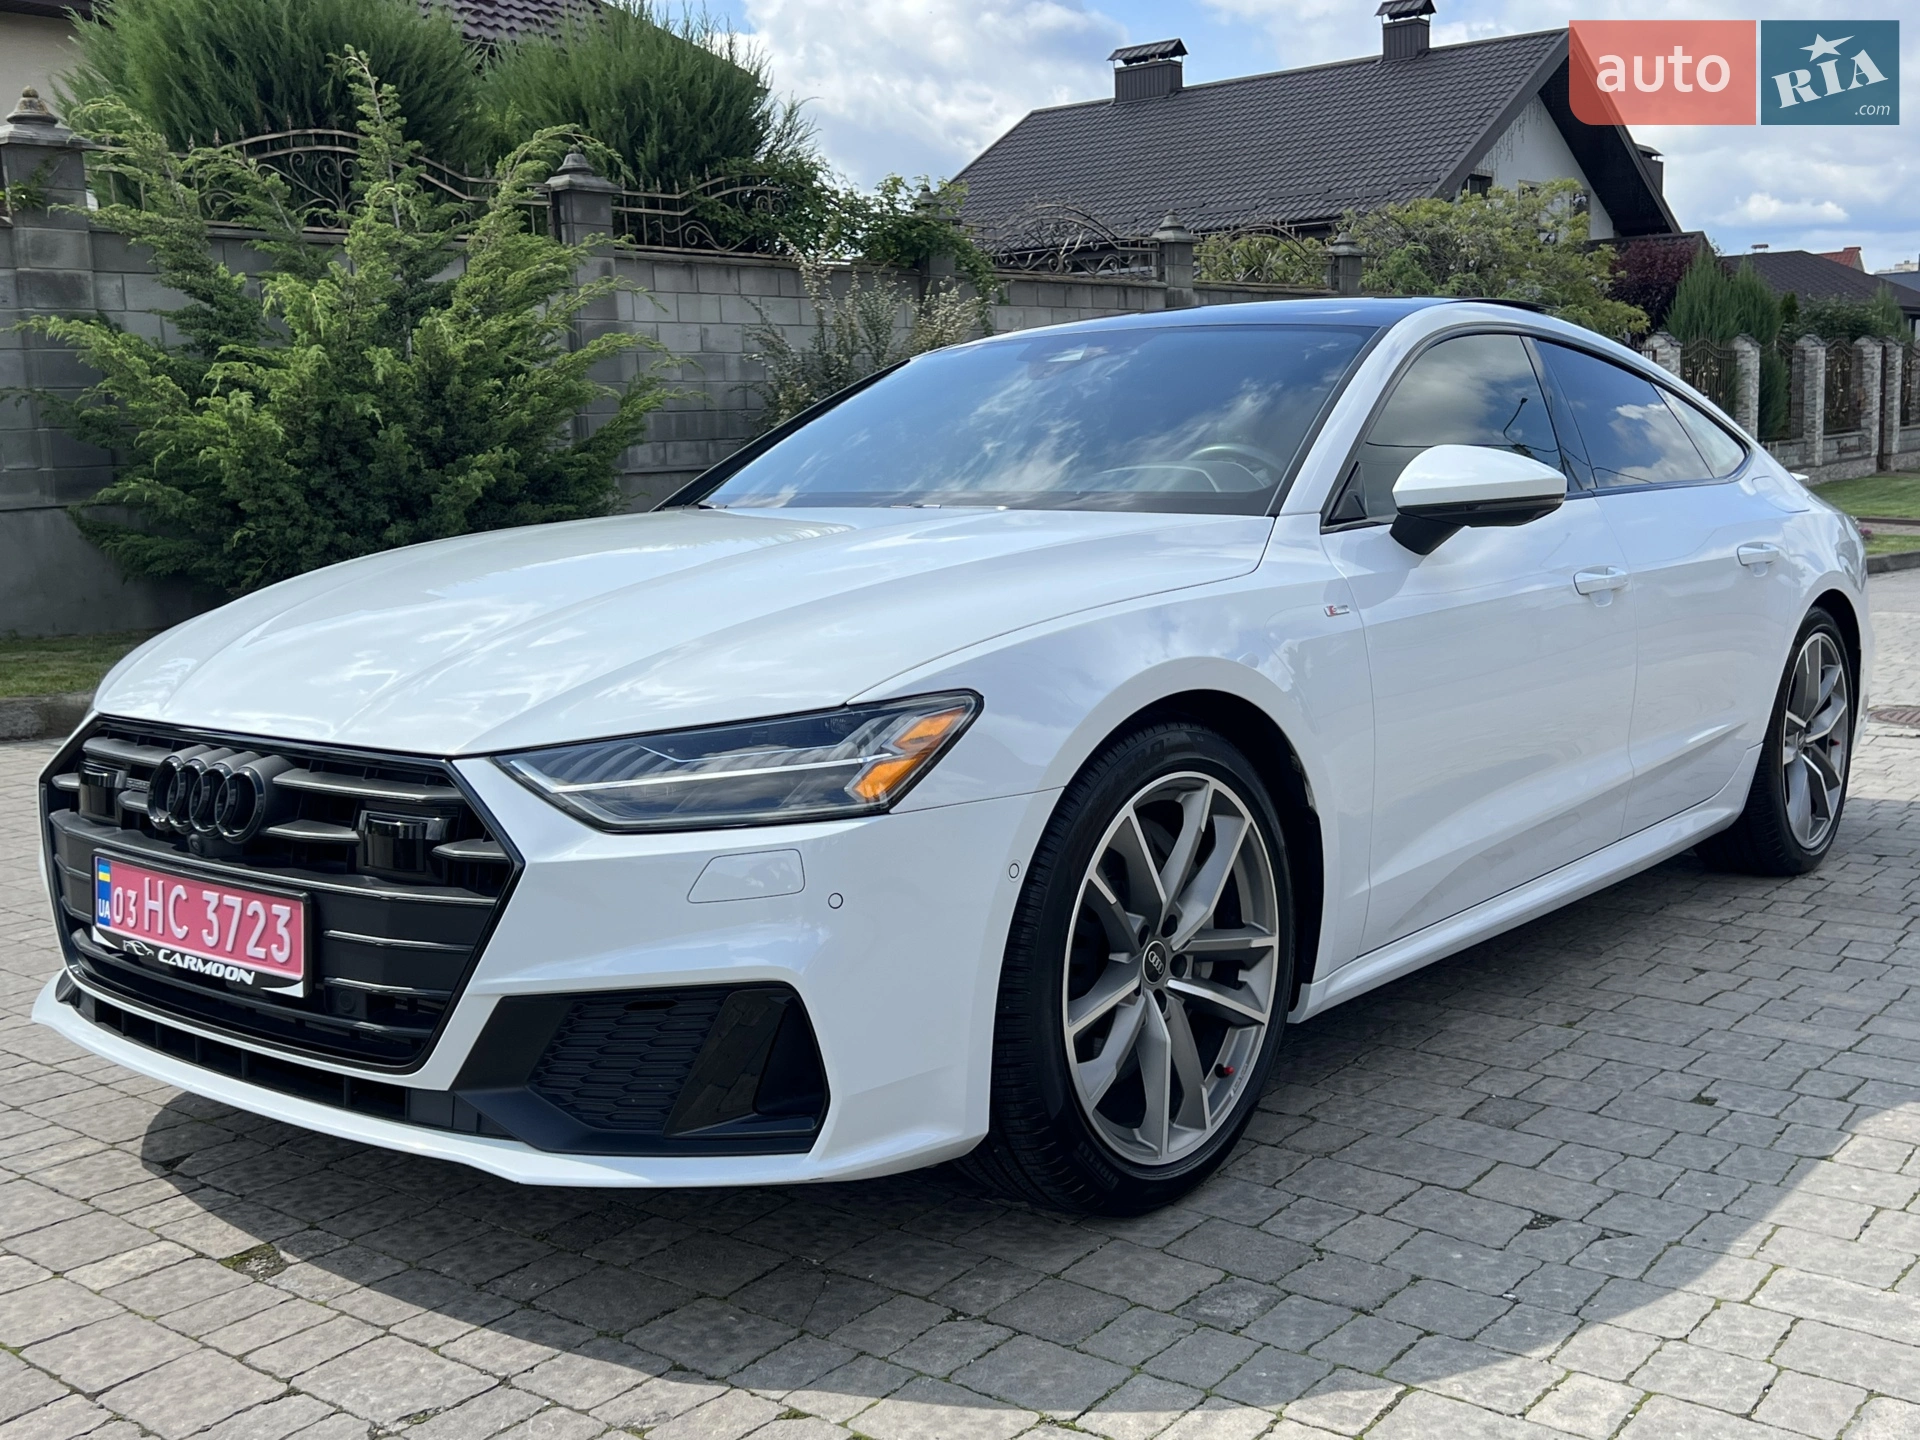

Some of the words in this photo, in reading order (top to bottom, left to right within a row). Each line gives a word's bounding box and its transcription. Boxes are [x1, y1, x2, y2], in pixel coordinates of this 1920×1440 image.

[98, 898, 111, 920] UA
[201, 890, 292, 963] 3723
[157, 949, 255, 985] CARMOON
